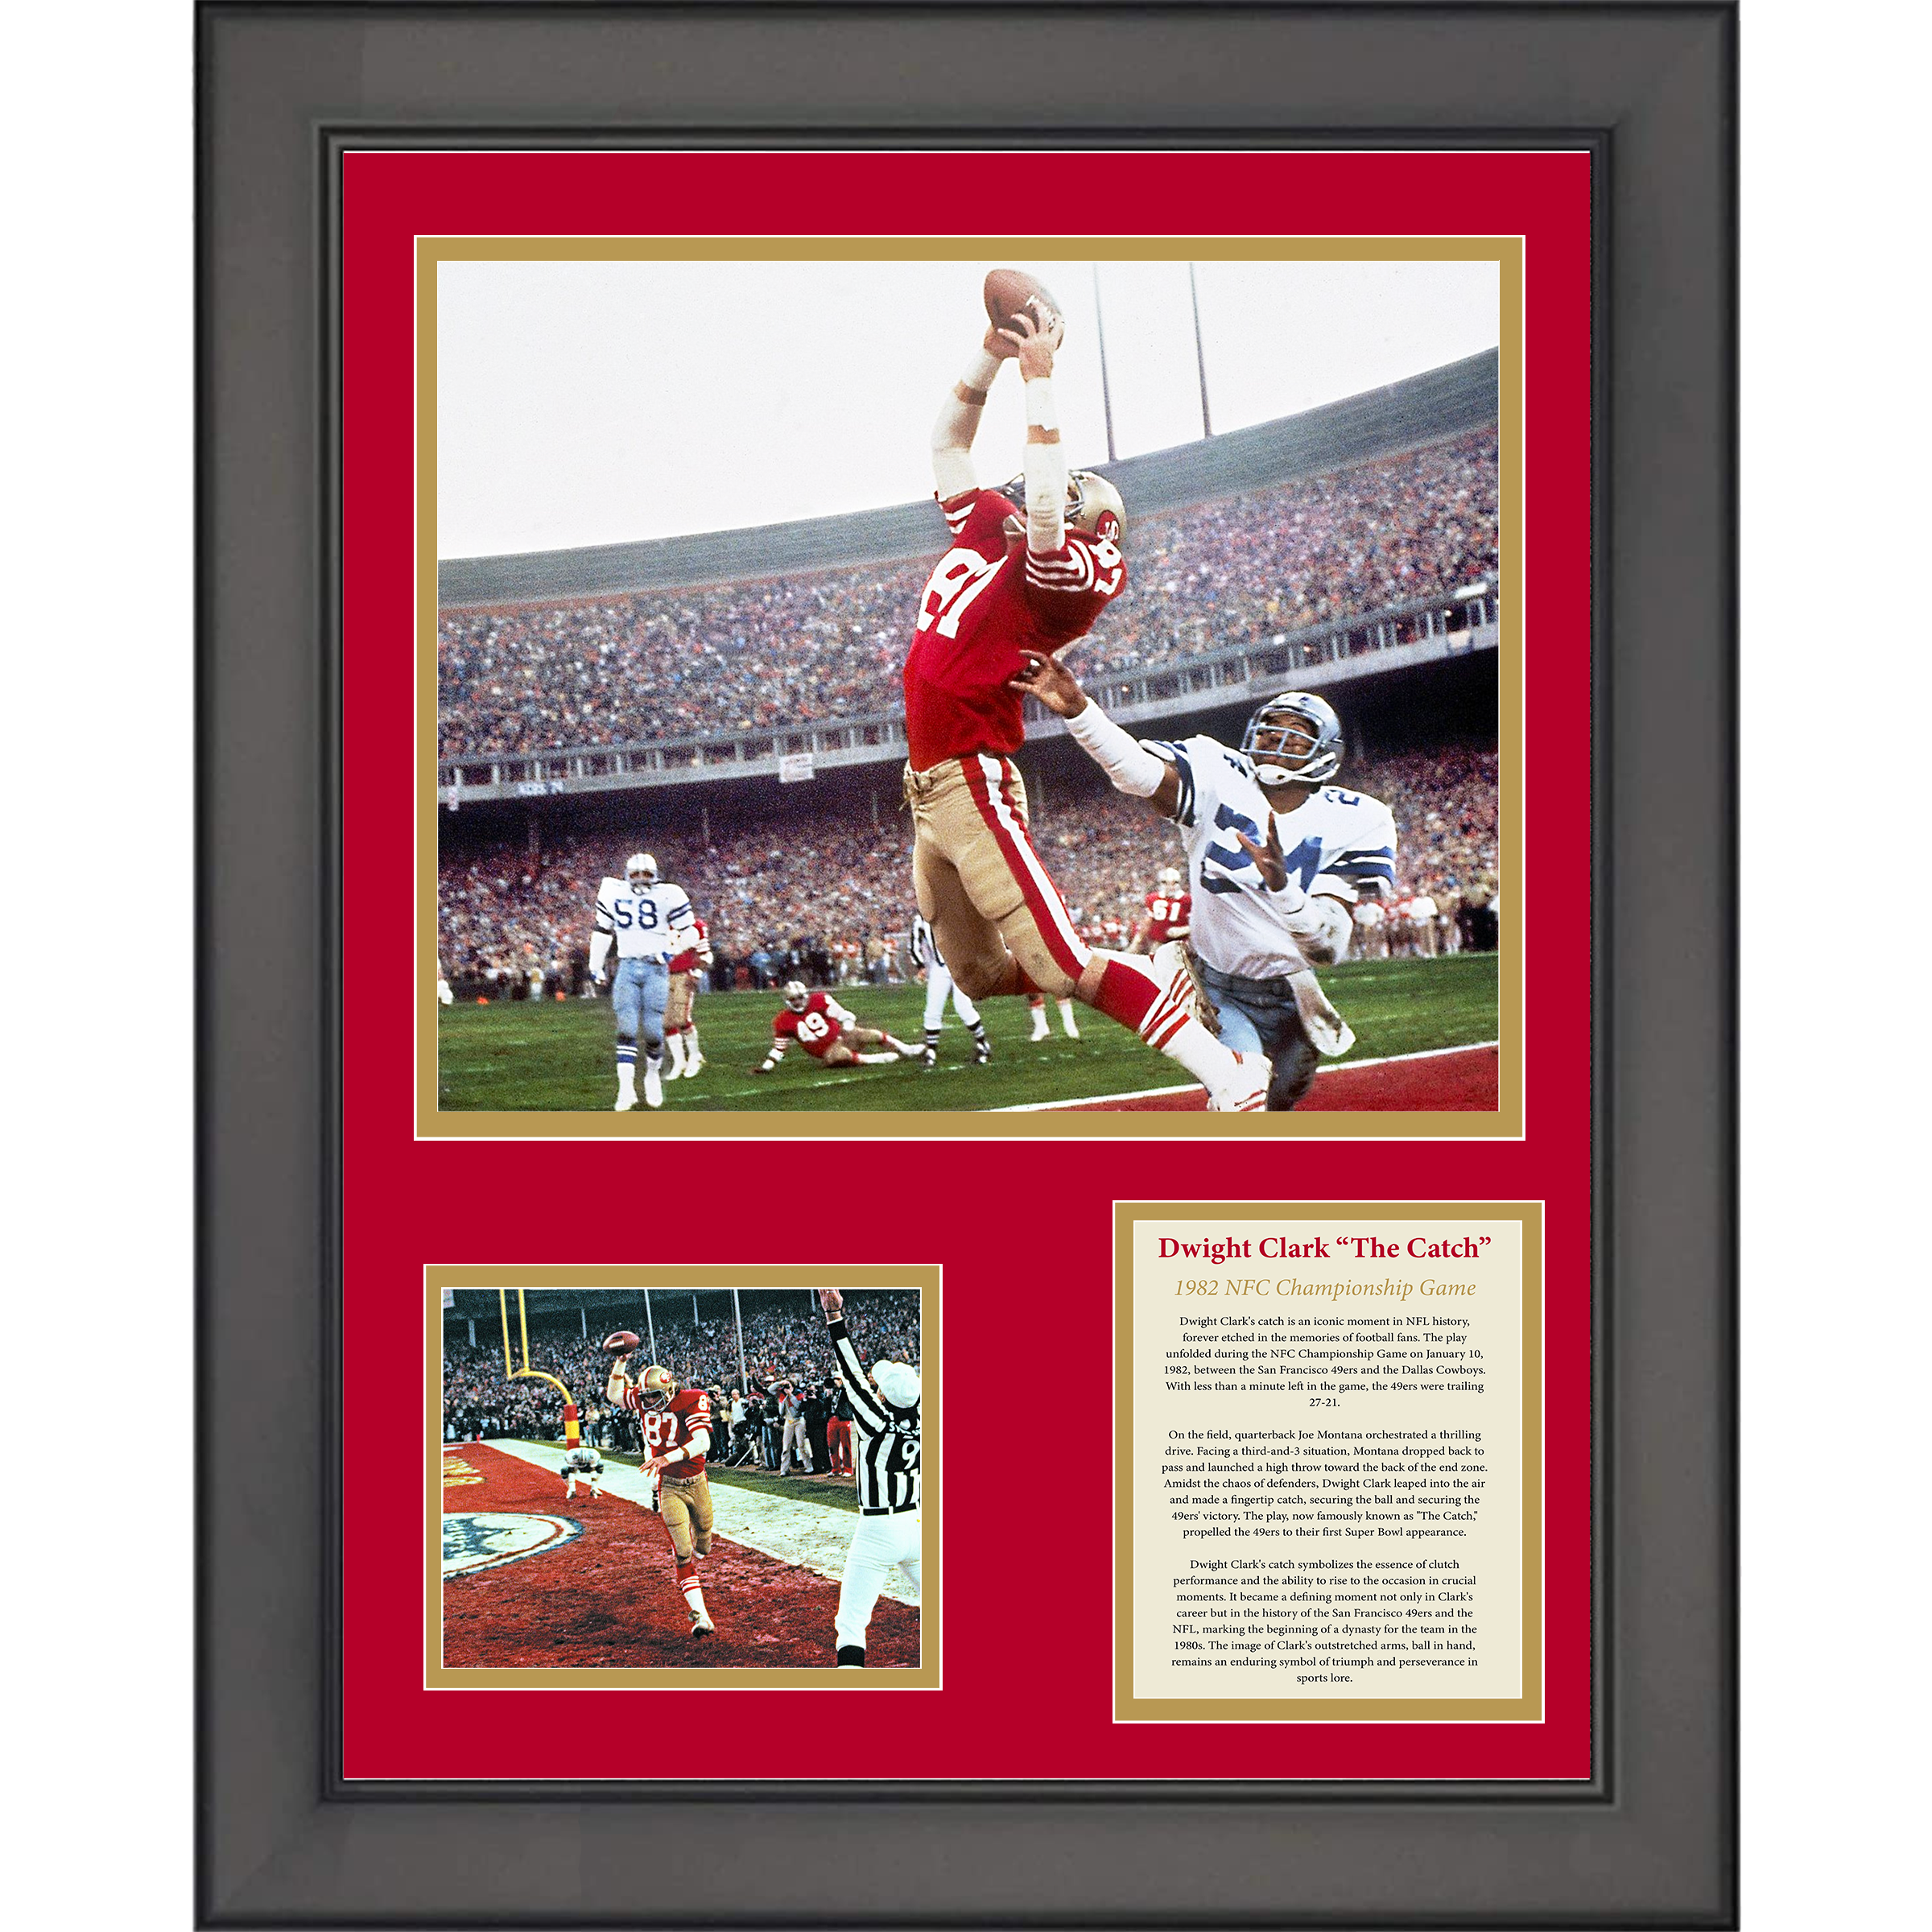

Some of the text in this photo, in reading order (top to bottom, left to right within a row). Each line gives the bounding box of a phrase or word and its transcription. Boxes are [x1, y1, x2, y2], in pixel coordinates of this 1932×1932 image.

[614, 898, 658, 930] 58
[797, 1012, 829, 1042] 49
[1158, 1236, 1492, 1265] Dwight Clark “The Catch”
[1174, 1278, 1476, 1302] 1982 NFC Championship Game
[1179, 1315, 1218, 1329] Dwight
[1220, 1315, 1256, 1327] Clark's
[1257, 1315, 1285, 1326] catch
[1287, 1316, 1296, 1327] is
[1313, 1316, 1345, 1327] iconic
[1347, 1318, 1390, 1327] moment
[1393, 1316, 1403, 1326] in
[1406, 1316, 1430, 1326] NFL
[1432, 1315, 1471, 1329] history,
[1166, 1348, 1484, 1361] unfolded during the NFC Championship Game on January 10,
[1164, 1364, 1486, 1377] 1982, between the San Francisco 49ers and the Dallas Cowboys.
[1165, 1381, 1484, 1394] With less than a minute left in the game, the 49ers were trailing
[1309, 1397, 1340, 1407] 27-21.
[644, 1410, 679, 1447] 87
[1168, 1430, 1185, 1440] On
[1187, 1429, 1204, 1439] the
[1206, 1429, 1232, 1441] field,
[1234, 1429, 1296, 1443] quarterback
[1298, 1430, 1315, 1441] Joe
[1316, 1430, 1363, 1440] Montana
[1365, 1429, 1429, 1440] orchestrated
[1439, 1429, 1482, 1443] thrilling
[1164, 1445, 1485, 1459] drive. Facing a third-and-3 situation, Montana dropped back to
[1163, 1478, 1486, 1491] Amidst the chaos of defenders, Dwight Clark leaped into the air
[1171, 1510, 1201, 1521] 49ers'
[1202, 1511, 1241, 1524] victory.
[1242, 1510, 1264, 1521] The
[1265, 1510, 1290, 1524] play,
[1316, 1510, 1364, 1524] famously
[1365, 1510, 1401, 1521] known
[1416, 1510, 1441, 1521] "The
[1443, 1510, 1478, 1522] Catch,"
[1183, 1526, 1467, 1540] propelled the 49ers to their first Super Bowl appearance.
[1190, 1558, 1460, 1572] Dwight Clark's catch symbolizes the essence of clutch
[1176, 1591, 1474, 1604] moments. It became a defining moment not only in Clark's
[1174, 1640, 1476, 1653] 1980s. The image of Clark's outstretched arms, ball in hand,
[1171, 1657, 1212, 1666] remains
[1229, 1656, 1278, 1670] enduring
[1278, 1656, 1317, 1670] symbol
[1319, 1656, 1331, 1666] of
[1331, 1656, 1375, 1670] triumph
[1377, 1656, 1397, 1666] and
[1398, 1659, 1466, 1670] perseverance
[1468, 1657, 1479, 1666] in
[1296, 1672, 1353, 1686] sports lore.
